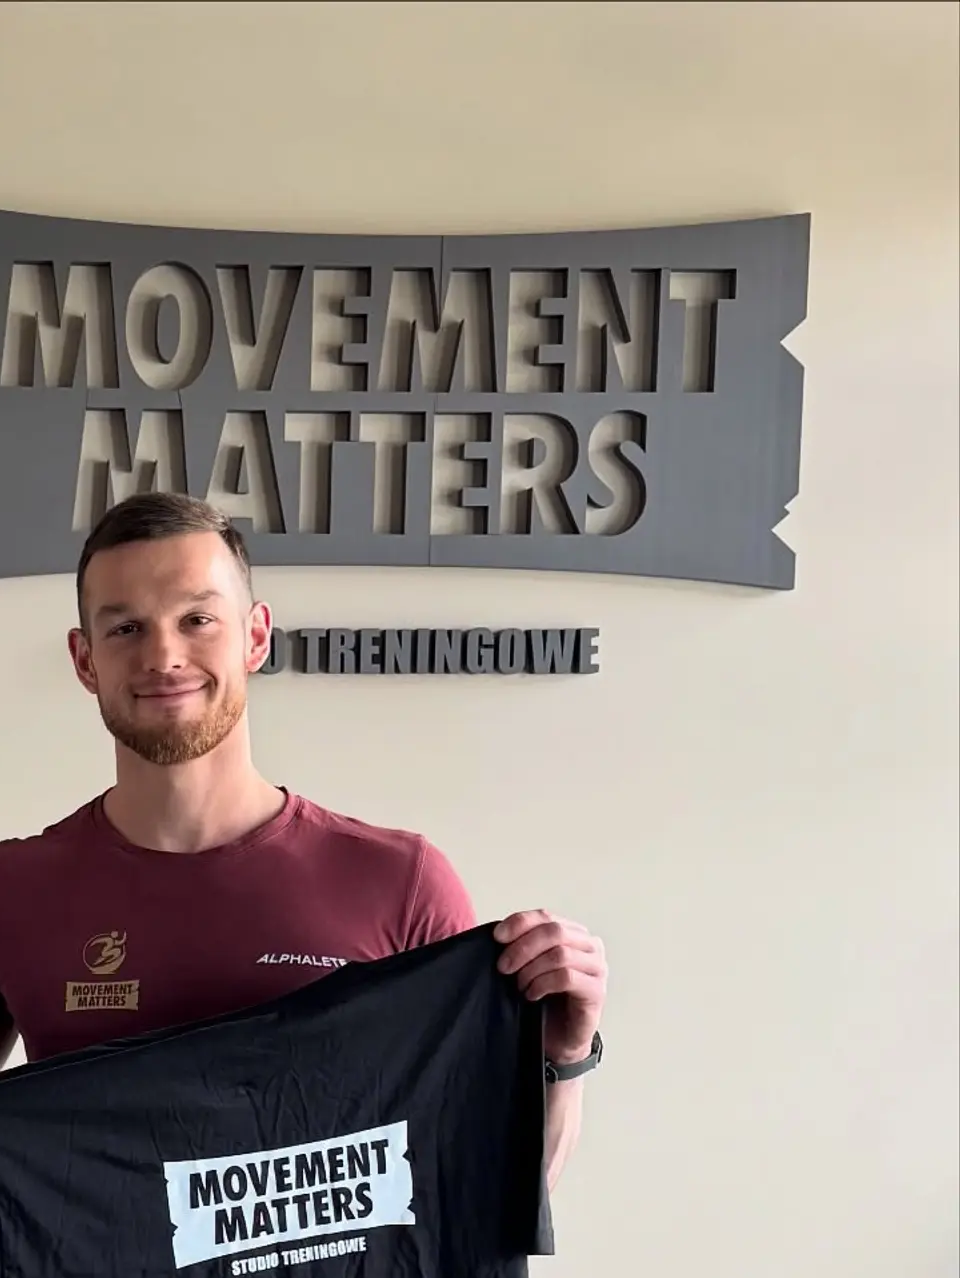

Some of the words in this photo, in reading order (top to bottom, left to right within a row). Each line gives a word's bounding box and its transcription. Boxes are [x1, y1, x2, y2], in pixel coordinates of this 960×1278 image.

[0, 259, 737, 393] MOVEMENT
[71, 407, 648, 536] MATTERS
[299, 627, 601, 675] TRENINGOWE
[72, 983, 133, 997] MOVEMENT
[77, 996, 127, 1008] MATTERS
[189, 1139, 388, 1209] MOVEMENT
[214, 1182, 374, 1245] MATTERS
[231, 1253, 279, 1276] STUDIO
[283, 1236, 367, 1266] TRENINGOWE
